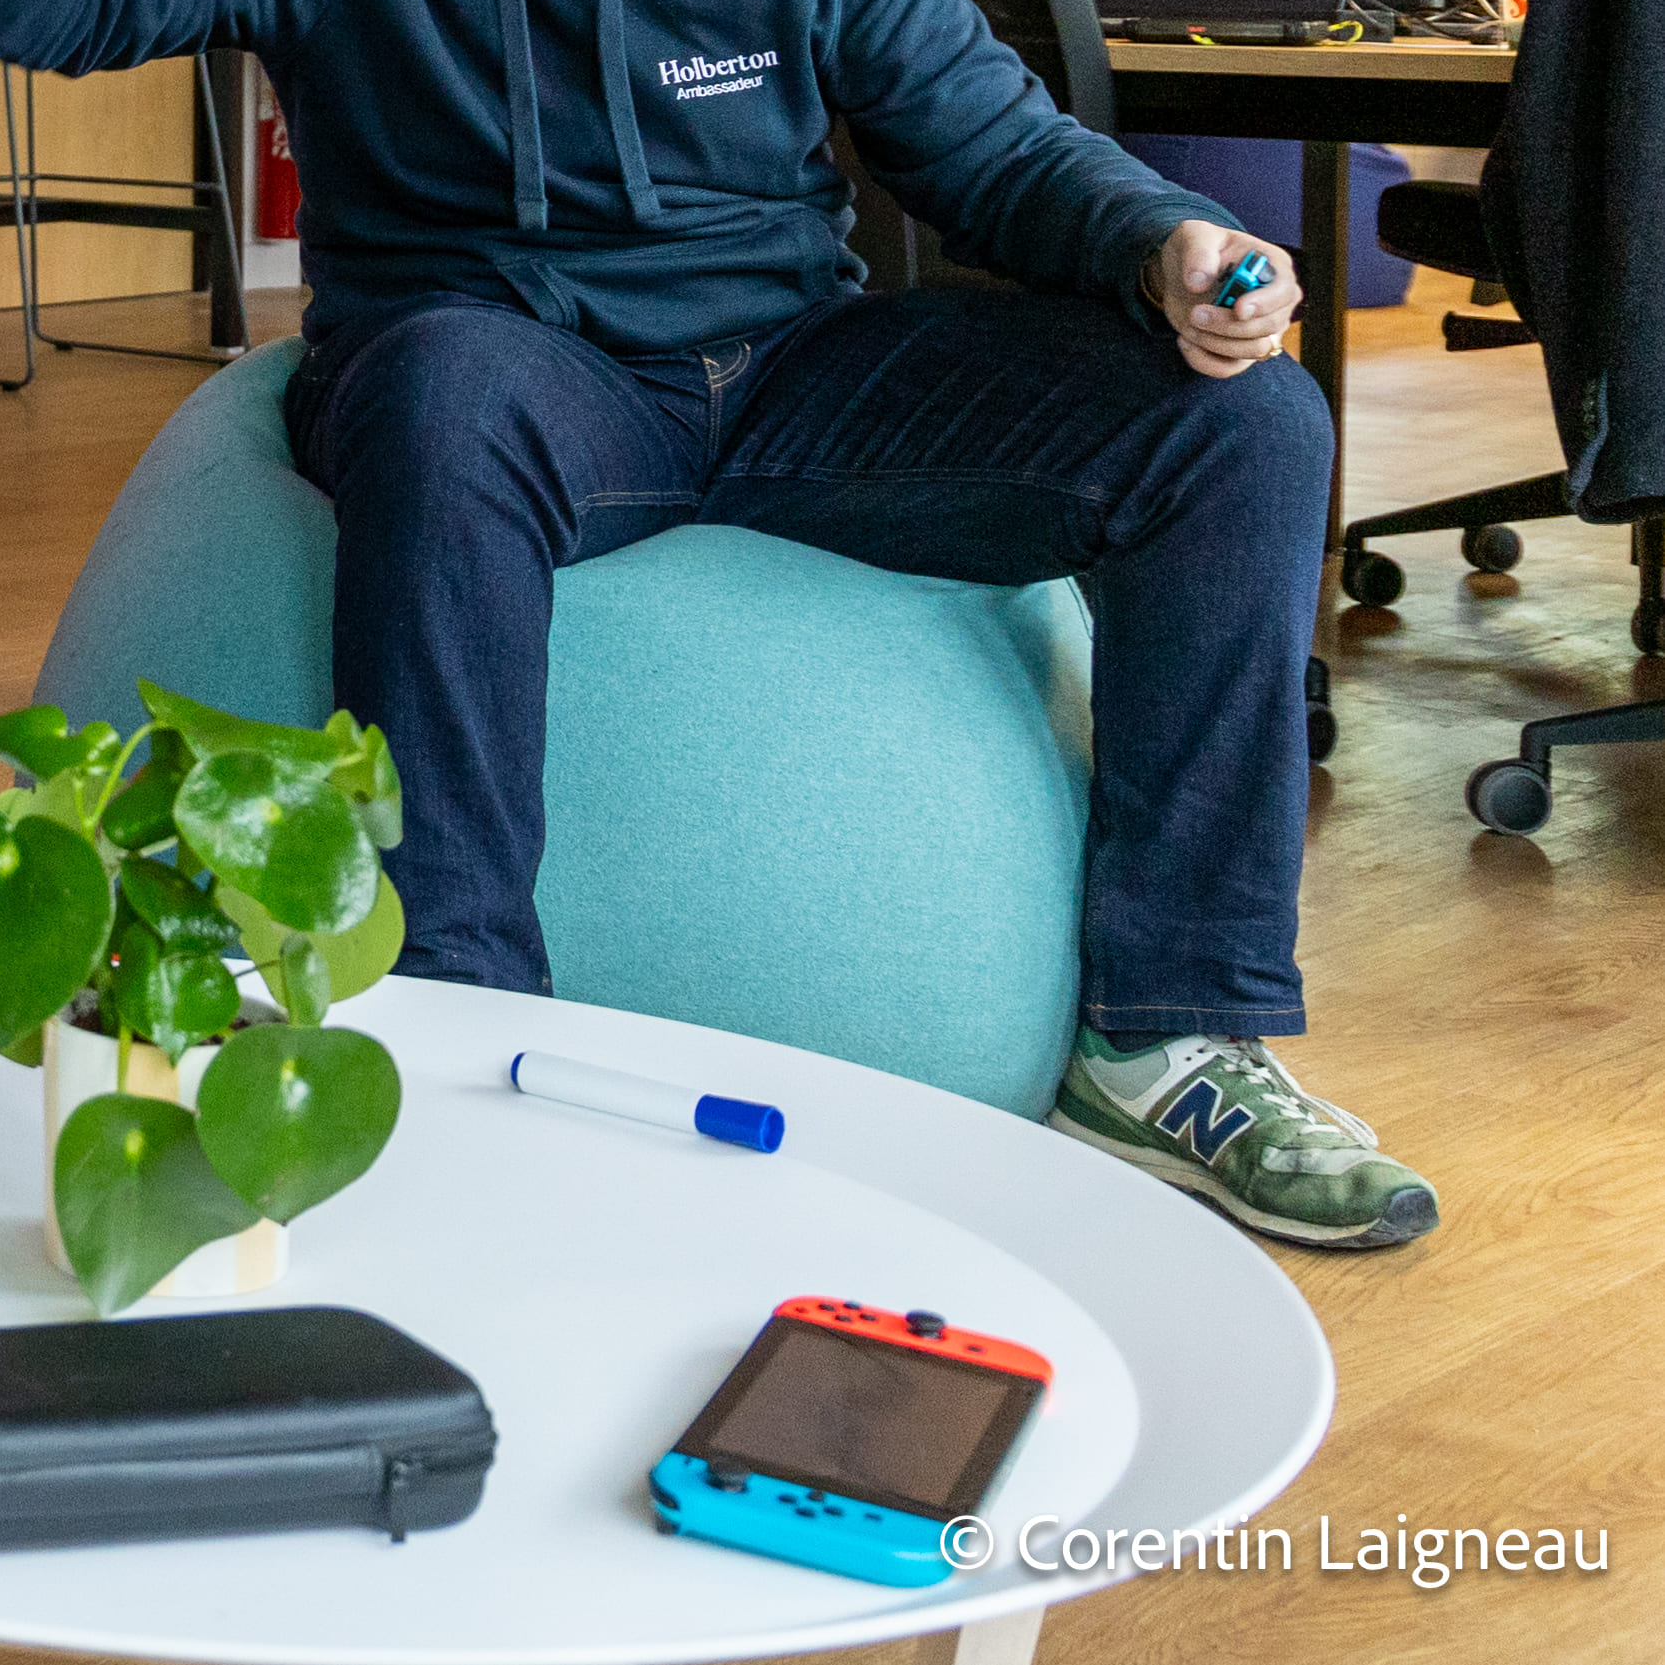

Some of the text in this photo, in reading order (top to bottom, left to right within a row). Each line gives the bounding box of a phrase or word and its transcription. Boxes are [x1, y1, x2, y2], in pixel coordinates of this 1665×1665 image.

[658, 50, 780, 86] Holberton
[676, 75, 764, 100] Ambassadeur
[1156, 1076, 1257, 1165] N
